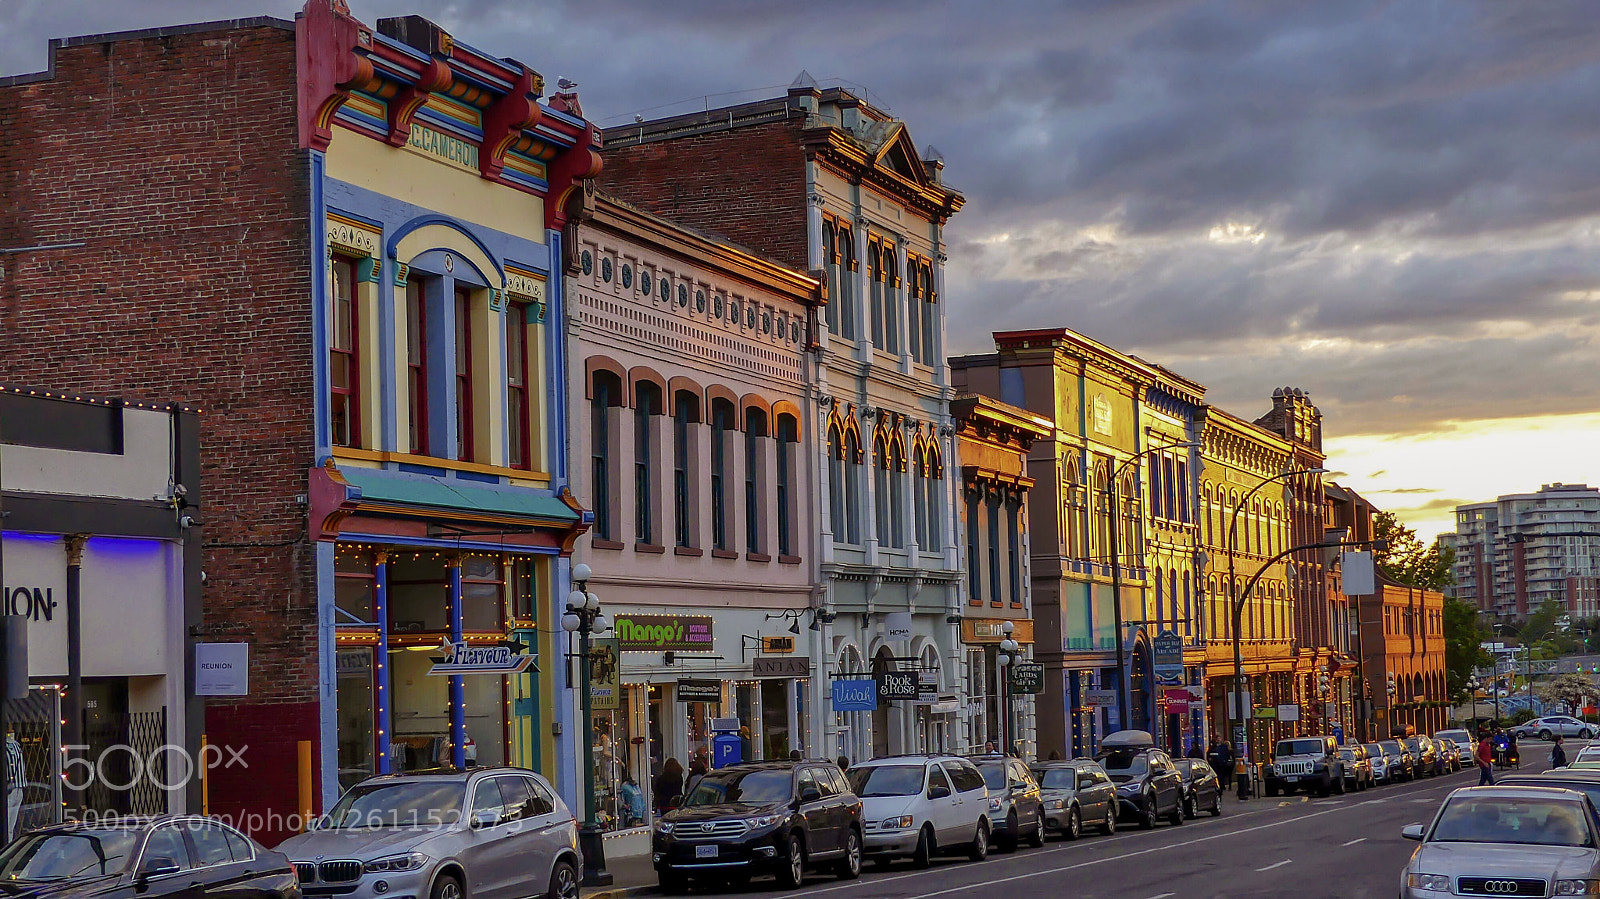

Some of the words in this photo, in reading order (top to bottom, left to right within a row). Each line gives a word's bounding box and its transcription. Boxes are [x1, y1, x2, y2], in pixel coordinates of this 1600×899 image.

[615, 618, 684, 647] Mango's
[453, 644, 509, 664] FLAVOUR
[884, 674, 912, 686] Rook
[888, 684, 915, 695] Rose
